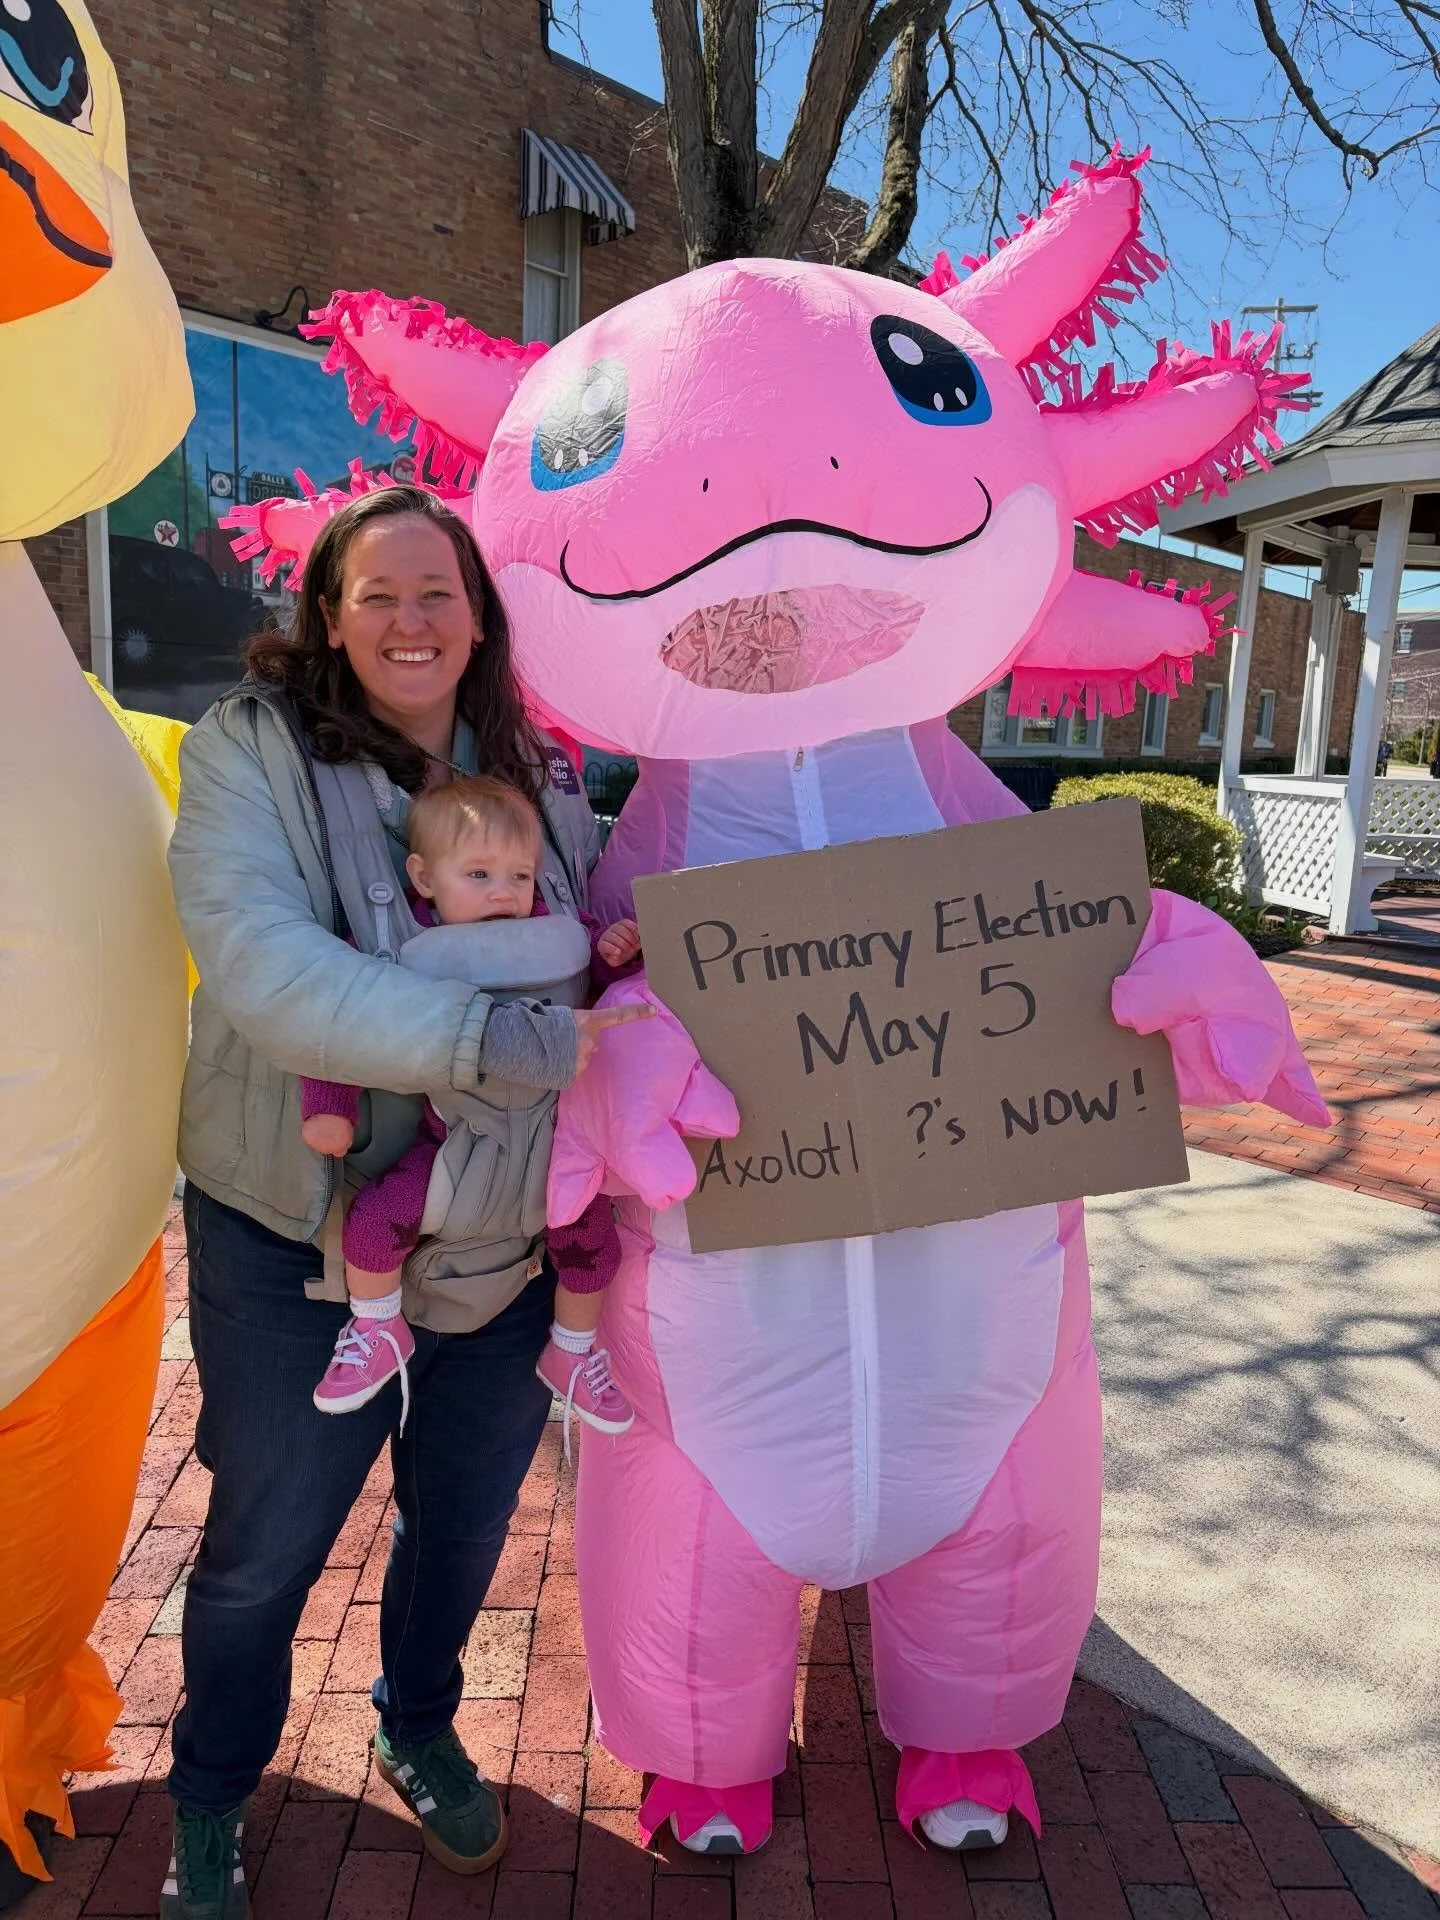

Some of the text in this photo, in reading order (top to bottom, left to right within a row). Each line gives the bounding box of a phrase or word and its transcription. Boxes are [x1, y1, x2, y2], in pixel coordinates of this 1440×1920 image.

[682, 879, 1137, 990] Primary Election
[796, 962, 1037, 1078] May 5
[697, 1067, 1147, 1194] Axolotl ?'s NOW!
